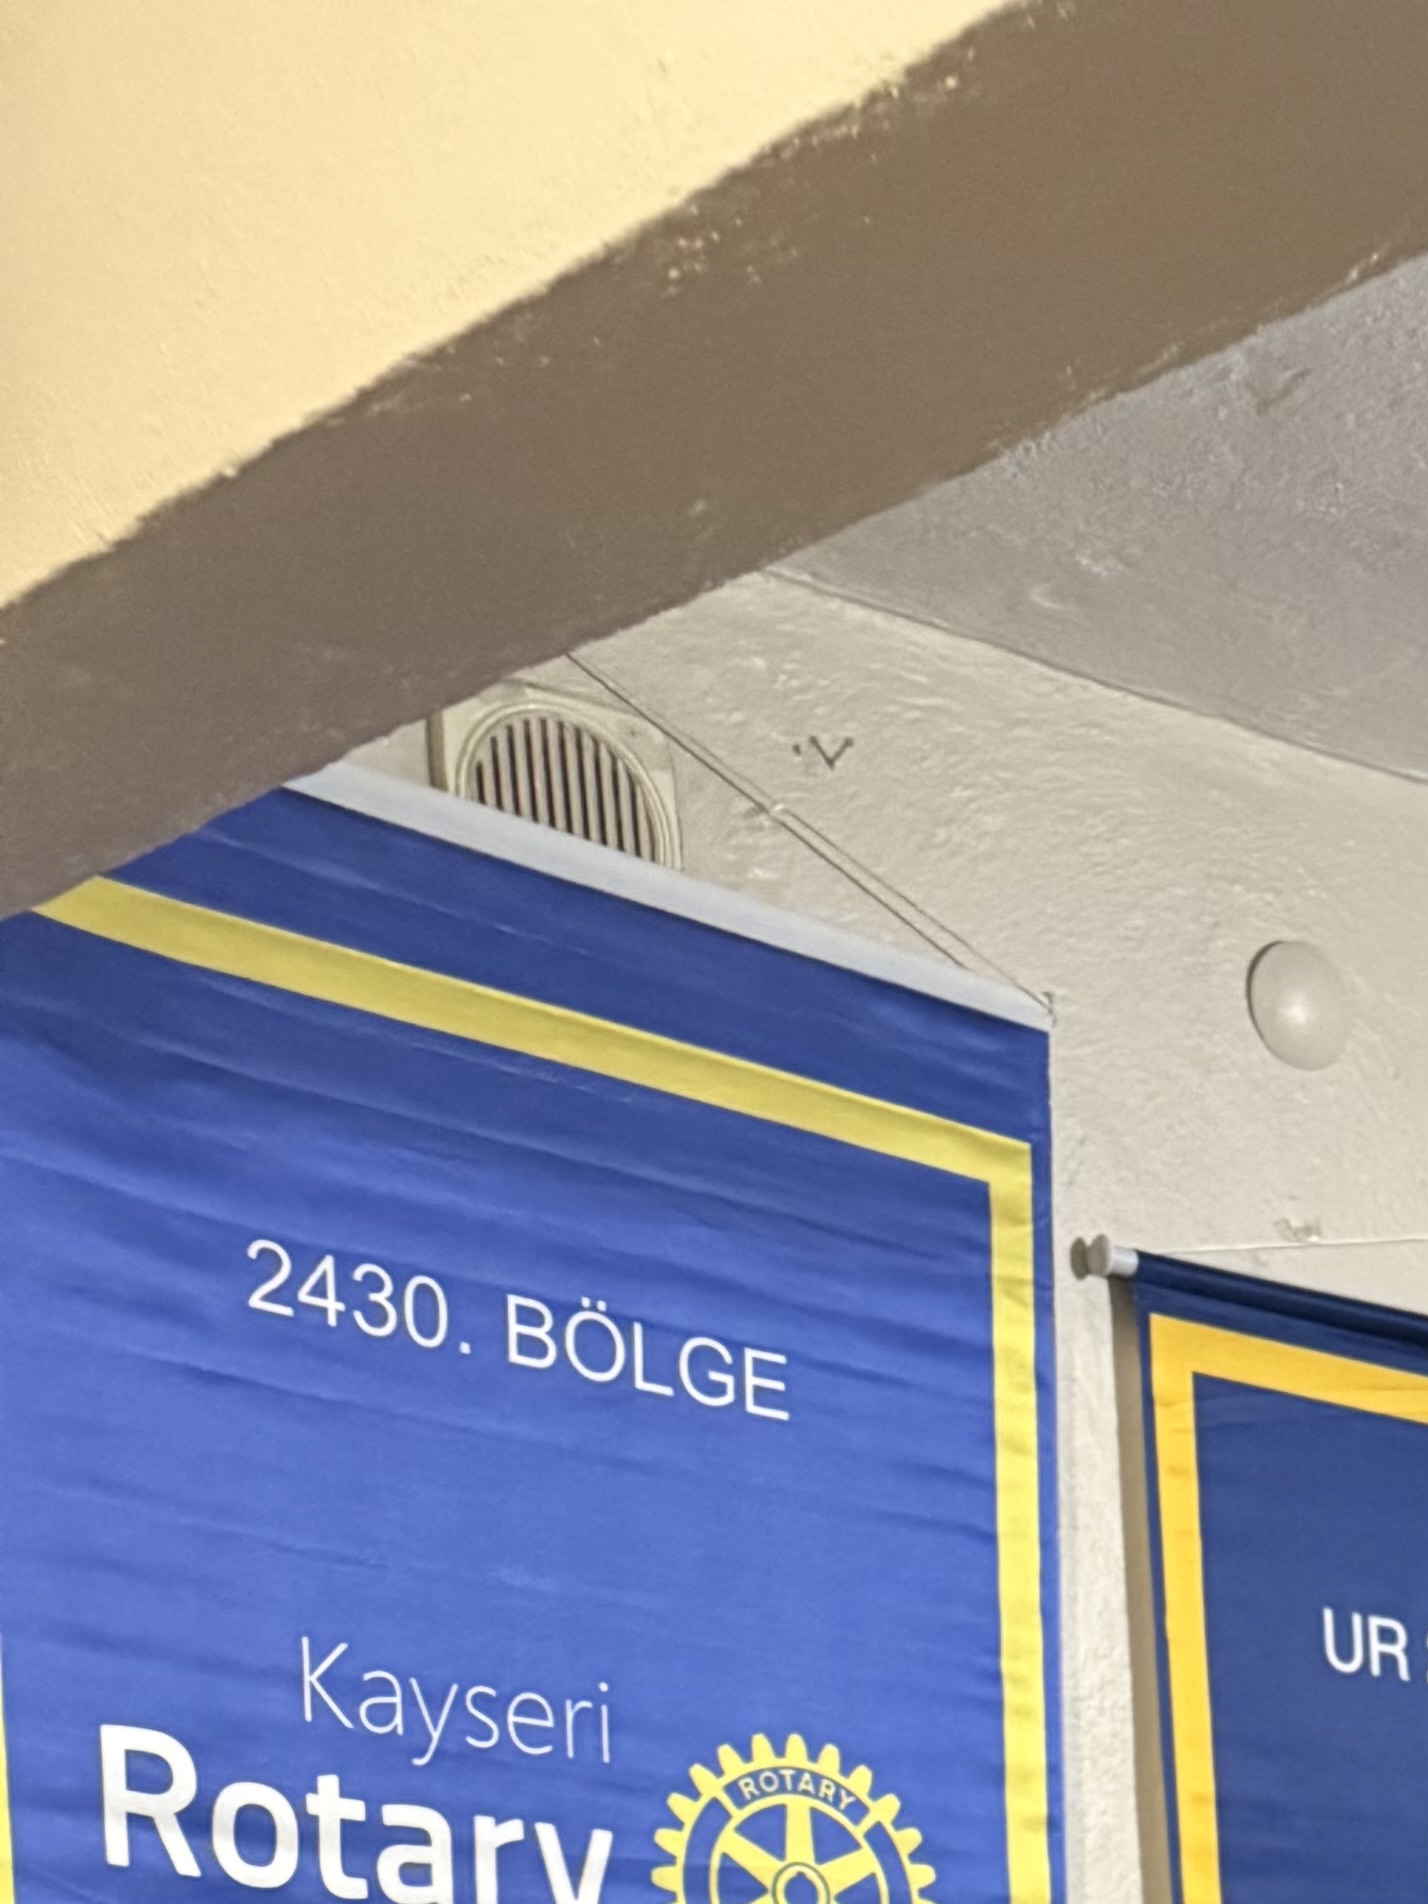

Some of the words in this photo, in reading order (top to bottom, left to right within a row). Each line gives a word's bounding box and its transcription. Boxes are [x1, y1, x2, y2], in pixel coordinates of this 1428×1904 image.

[246, 1238, 472, 1356] 2430.
[506, 1295, 791, 1422] BÖLGE
[1322, 1606, 1411, 1682] UR
[300, 1635, 611, 1767] Kayseri
[738, 1769, 856, 1811] ROTARY
